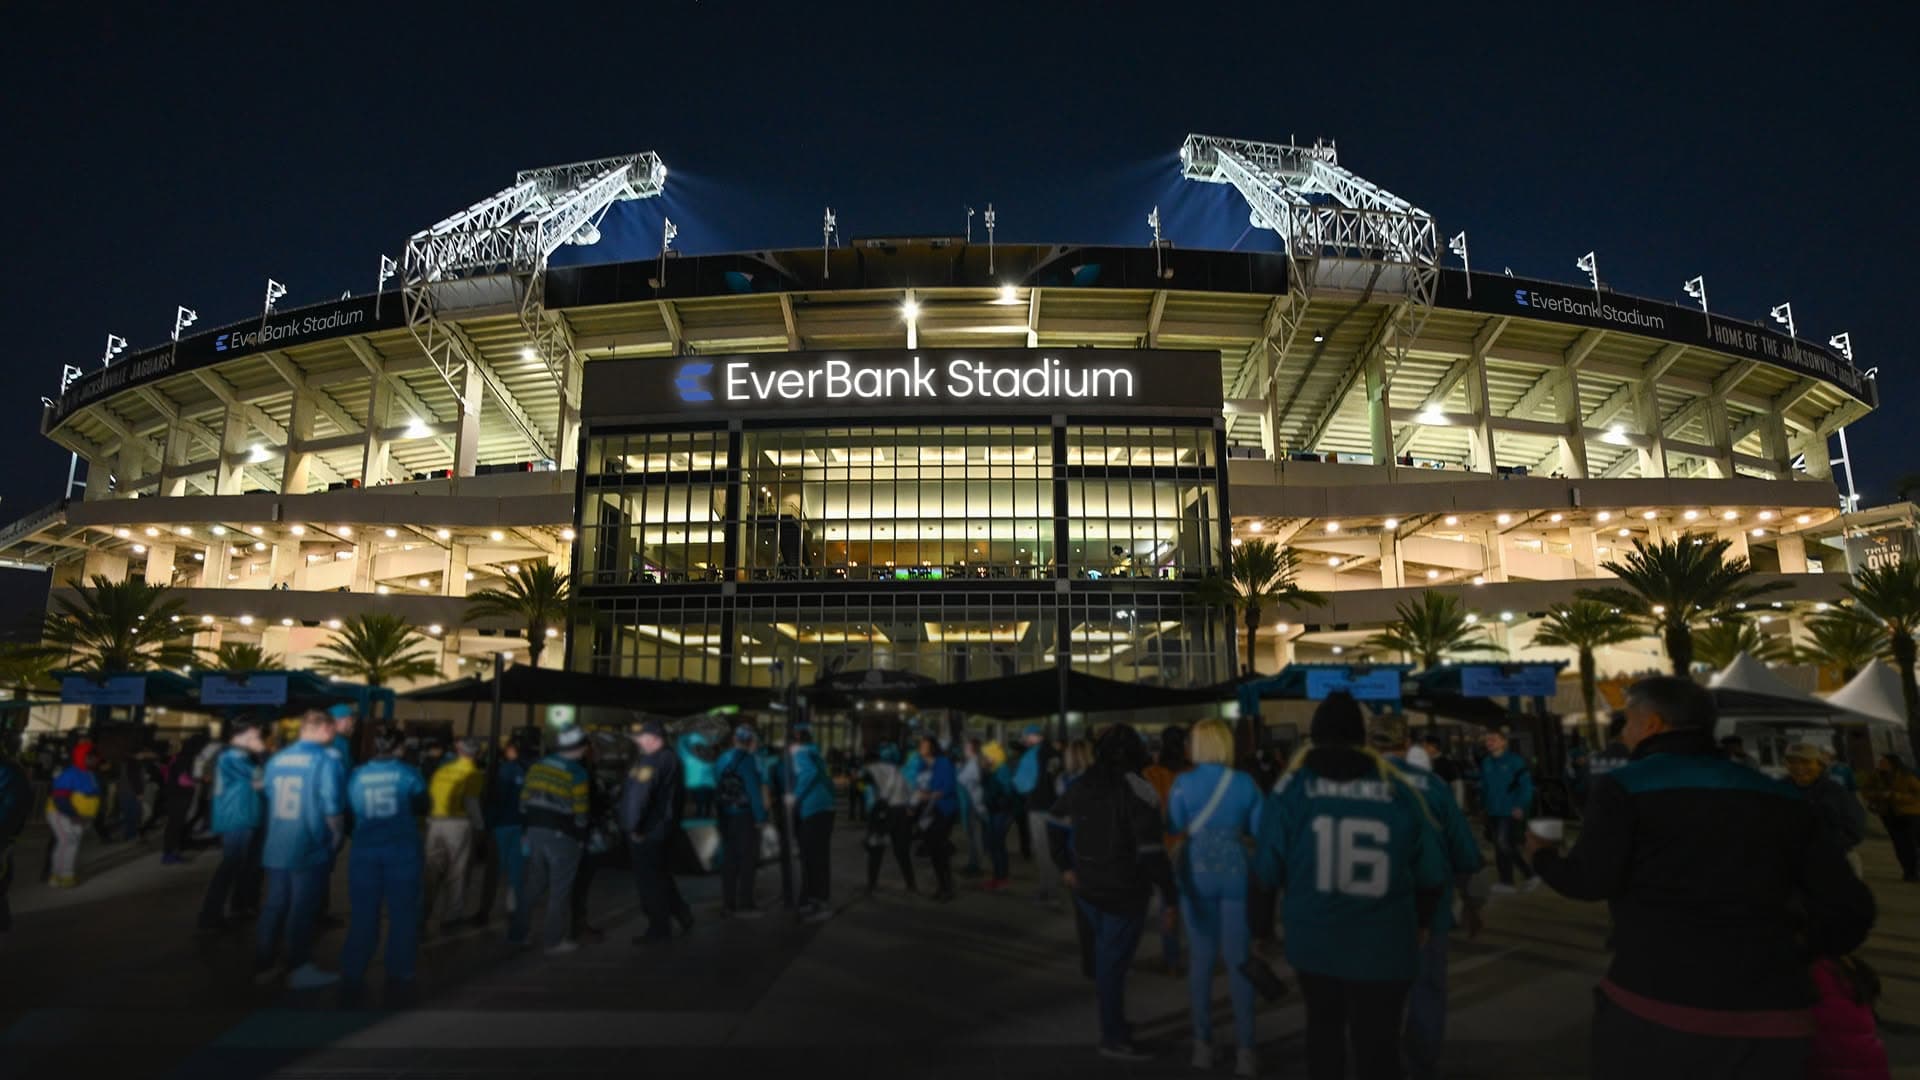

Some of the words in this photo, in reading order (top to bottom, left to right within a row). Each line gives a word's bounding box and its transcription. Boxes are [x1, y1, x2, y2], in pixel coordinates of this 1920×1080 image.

[230, 318, 300, 349] EverBank
[302, 309, 362, 334] Stadium
[1530, 291, 1599, 317] EverBank
[1602, 304, 1664, 329] Stadium
[1714, 325, 1744, 348] HOME
[1745, 333, 1758, 351] OF
[1761, 337, 1779, 357] THE
[727, 357, 937, 400] EverBank
[947, 358, 1133, 397] Stadium
[1868, 552, 1900, 570] OUR
[272, 776, 304, 820] 16
[1311, 815, 1391, 899] 16
